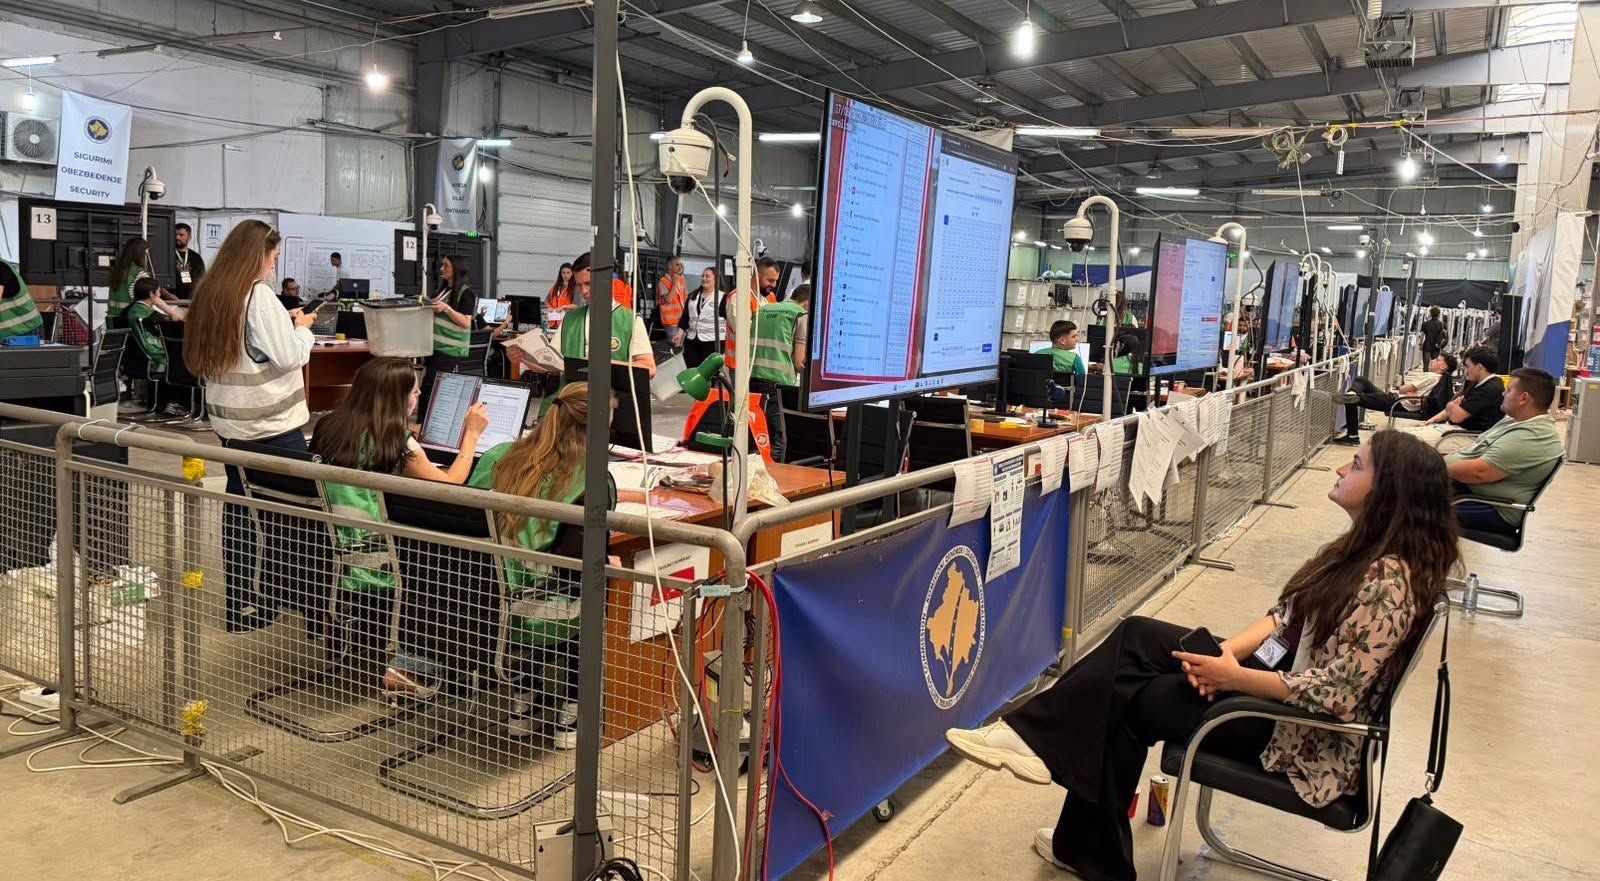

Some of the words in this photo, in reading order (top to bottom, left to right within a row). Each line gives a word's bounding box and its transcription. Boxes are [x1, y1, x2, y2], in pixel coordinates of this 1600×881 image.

[73, 151, 113, 165] SIGURIMI
[69, 185, 110, 198] SECURITY
[36, 213, 51, 223] 13
[406, 241, 416, 249] 12
